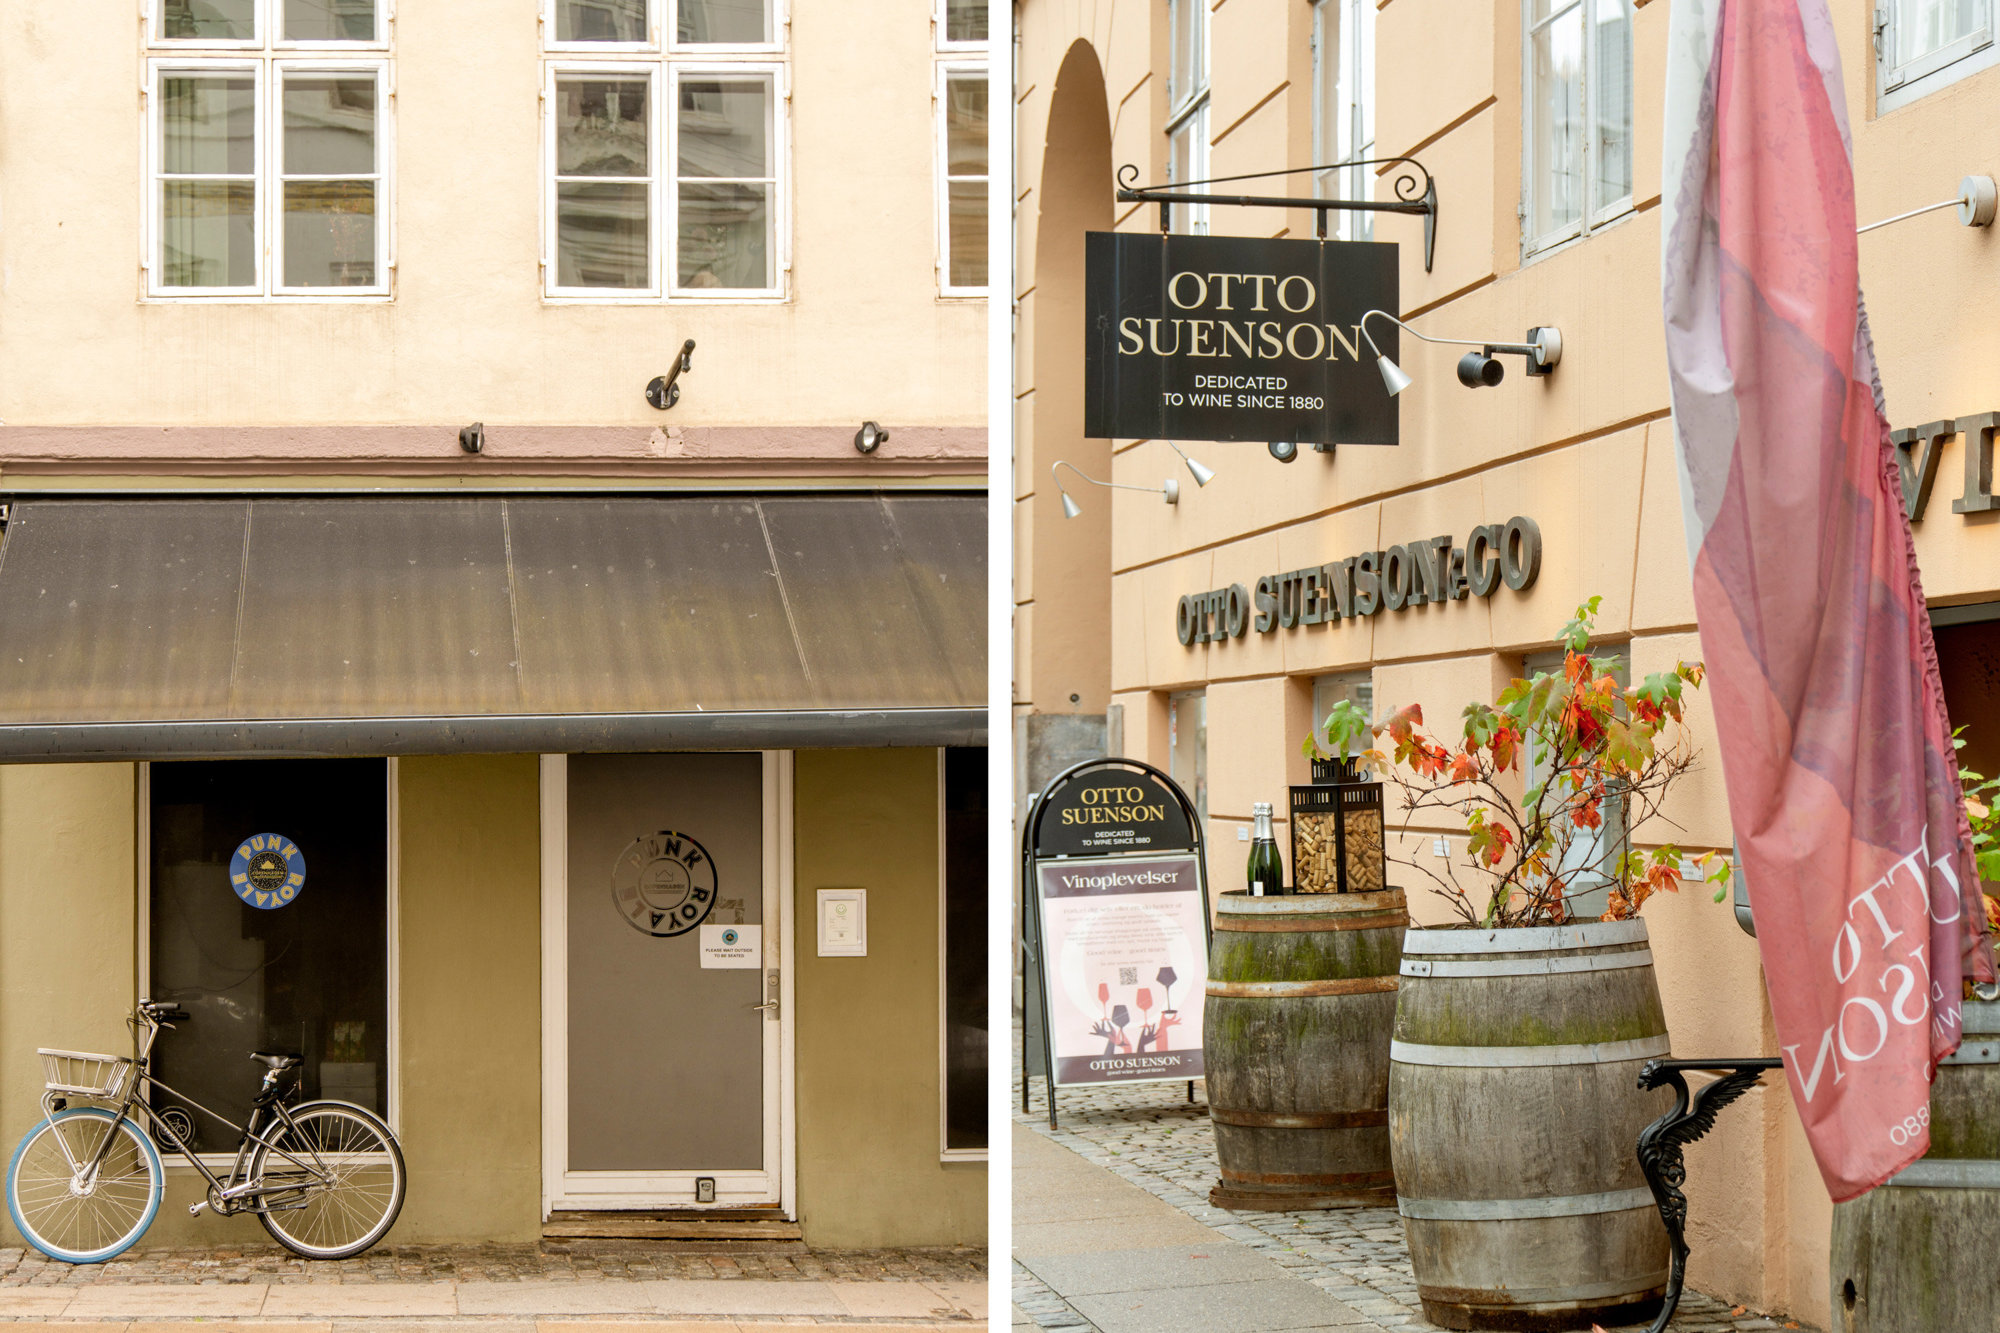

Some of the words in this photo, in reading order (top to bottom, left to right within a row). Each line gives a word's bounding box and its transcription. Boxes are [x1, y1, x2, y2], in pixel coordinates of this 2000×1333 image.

[1168, 271, 1316, 313] OTTO
[1118, 317, 1362, 362] SUENSON
[1195, 375, 1288, 390] DEDICATED
[1164, 393, 1184, 406] TO
[1188, 394, 1233, 407] WINE
[1237, 394, 1285, 409] SINCE
[1289, 396, 1325, 410] 1880
[1177, 582, 1250, 647] OTTO
[1080, 786, 1145, 805] OTTO
[1061, 804, 1165, 825] SUENSON
[1094, 830, 1135, 838] DEDICATED
[237, 834, 298, 860] PUNK
[627, 837, 703, 871] PUNK
[232, 872, 304, 908] ROYALE
[1062, 871, 1179, 890] Vinoplevelser
[619, 886, 710, 930] ROYALE
[1089, 1058, 1125, 1071] OTTO
[1126, 1055, 1181, 1069] SUENSON
